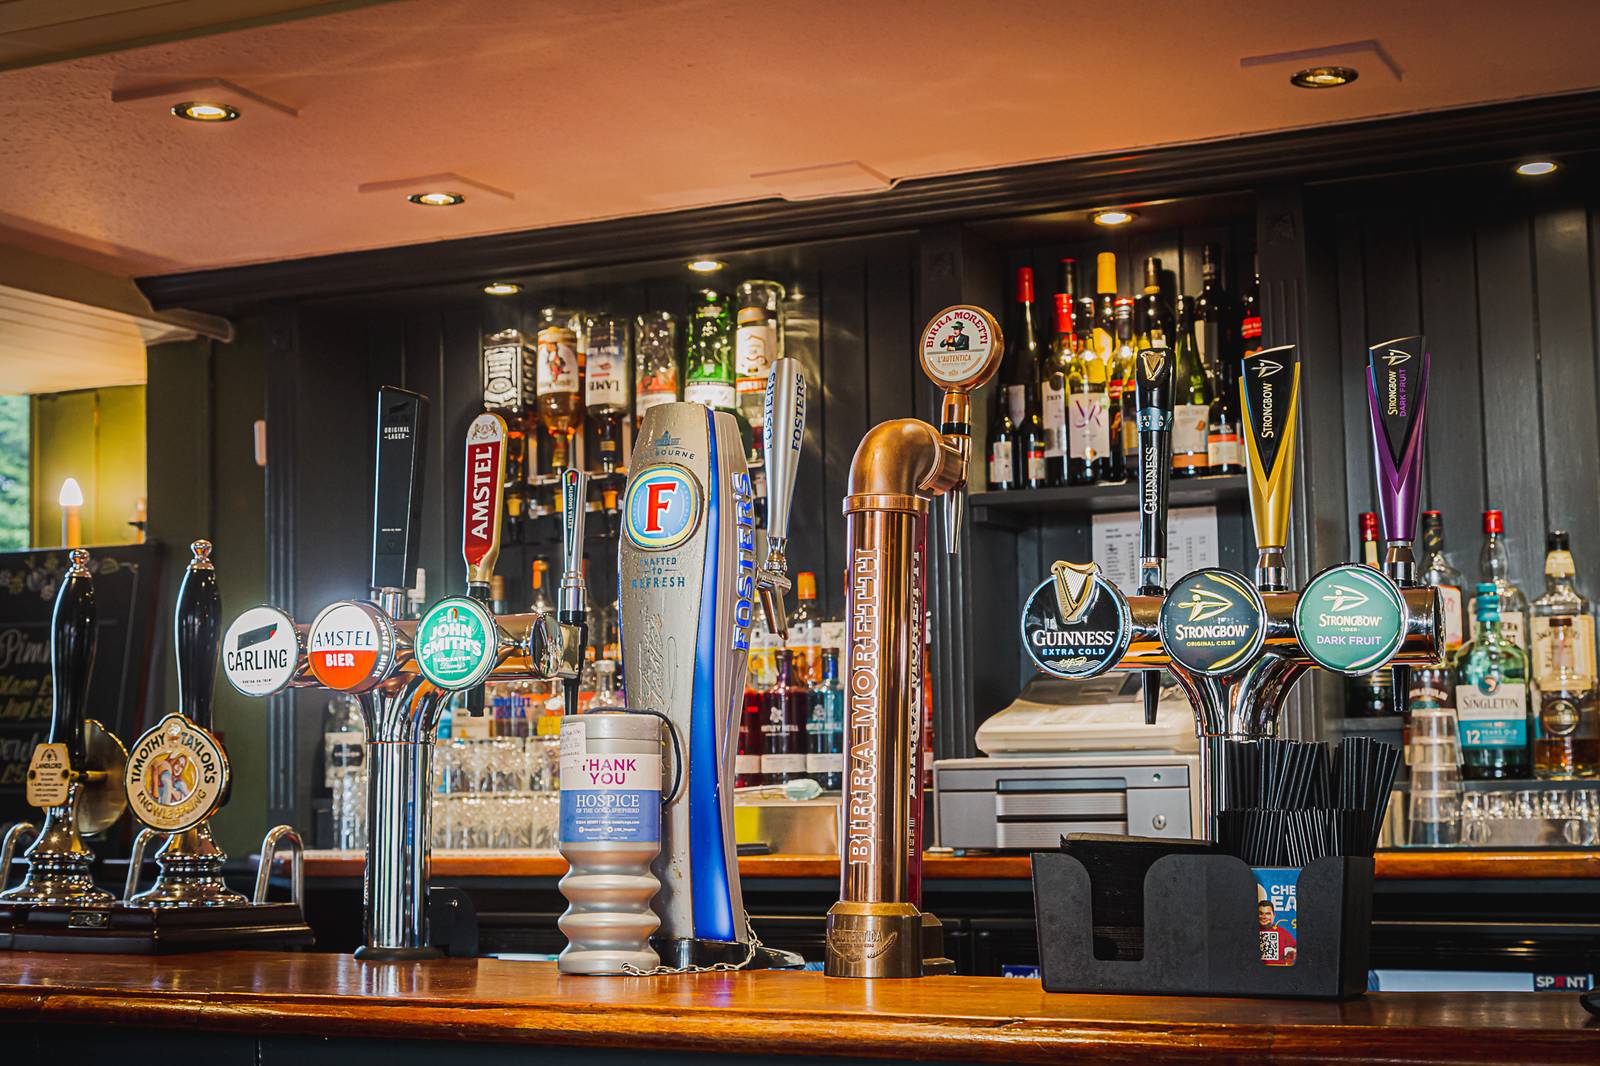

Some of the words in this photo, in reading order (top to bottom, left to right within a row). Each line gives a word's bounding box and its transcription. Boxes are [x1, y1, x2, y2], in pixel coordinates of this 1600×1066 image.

[925, 314, 953, 348] BIRRA
[954, 311, 989, 345] MORETTI
[1388, 371, 1398, 416] STRONGBOW
[792, 373, 804, 452] FOSTER'S
[1261, 382, 1274, 438] STRONGBOW
[1143, 447, 1158, 515] GUINNESS
[471, 446, 492, 540] AMSTEL
[643, 481, 679, 534] F
[731, 472, 754, 651] FOSTER'S
[631, 577, 685, 588] REFRESH
[1319, 613, 1382, 627] STRONGBOW
[314, 630, 374, 647] AMSTEL
[430, 622, 473, 642] JOHN
[851, 548, 880, 729] MORETTI
[1032, 630, 1115, 646] GUINNESS
[1175, 624, 1249, 641] STRONGBOW
[1316, 636, 1347, 645] DARK
[1349, 636, 1382, 645] FRUIT
[422, 637, 482, 660] SMITH'S
[1042, 648, 1075, 656] EXTRA
[1078, 648, 1106, 656] COLD
[228, 650, 288, 672] CARLING
[325, 653, 356, 667] BIER
[1463, 697, 1520, 709] SINGLETON
[1466, 730, 1481, 744] 12
[131, 733, 166, 784] TIMOTHY
[181, 732, 218, 784] TAYLOR'S
[589, 772, 626, 785] YOU
[576, 794, 640, 808] HOSPICE
[848, 738, 879, 866] BIRRA
